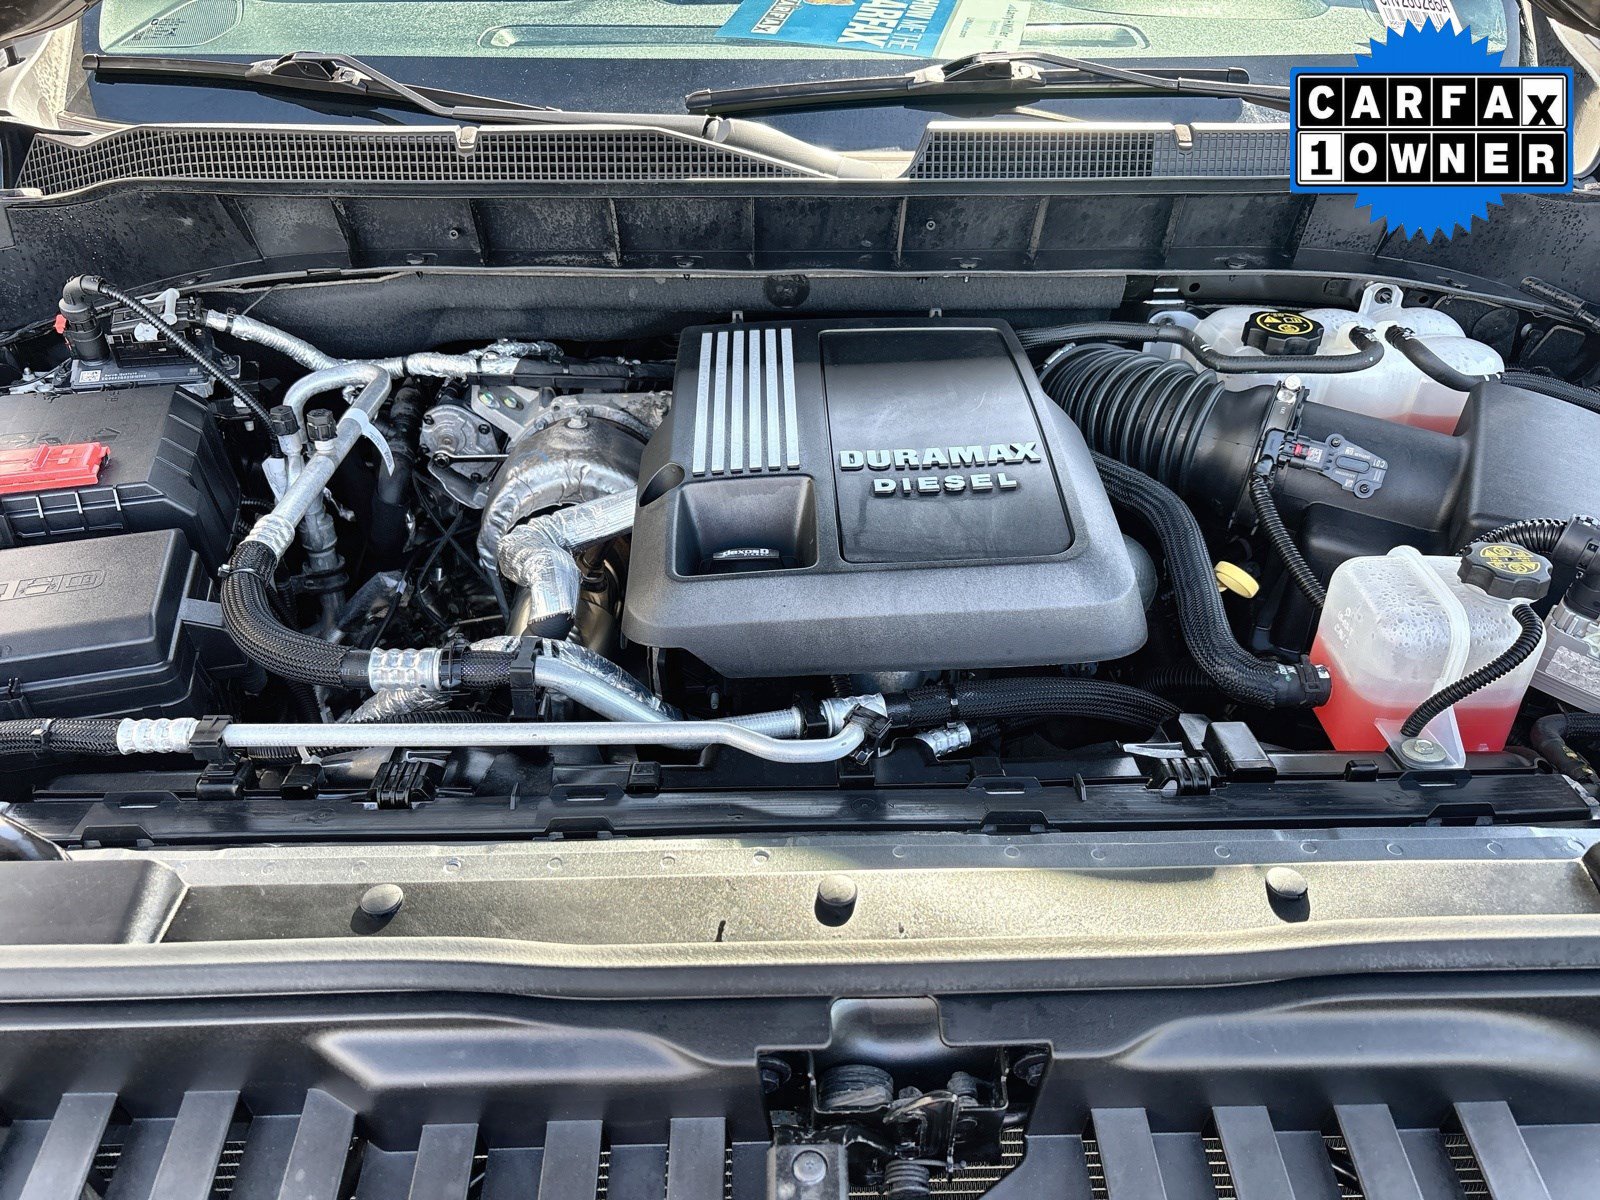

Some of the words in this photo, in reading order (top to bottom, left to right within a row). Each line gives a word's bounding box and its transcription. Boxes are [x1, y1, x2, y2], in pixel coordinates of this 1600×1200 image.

[896, 18, 930, 33] ME
[886, 32, 924, 51] THE
[194, 328, 202, 336] 2
[839, 441, 1042, 471] DURAMAX
[873, 472, 1018, 494] DIESEL
